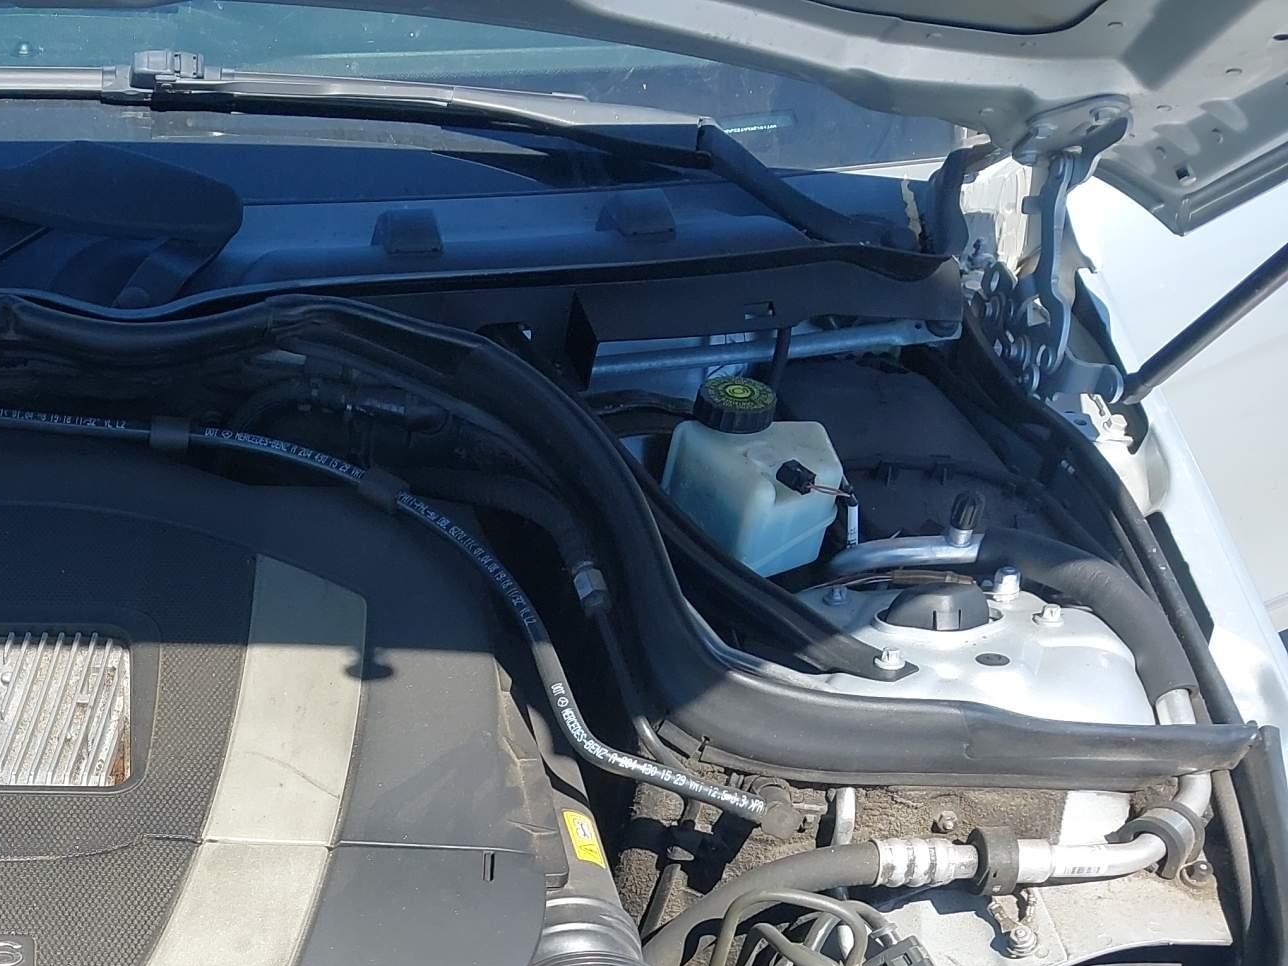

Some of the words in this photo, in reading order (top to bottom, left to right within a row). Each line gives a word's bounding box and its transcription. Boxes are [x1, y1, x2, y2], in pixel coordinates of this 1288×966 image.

[561, 708, 608, 759] MERCEDES-BENZ
[619, 756, 638, 770] 204
[660, 769, 672, 781] 15
[673, 773, 687, 786] 29
